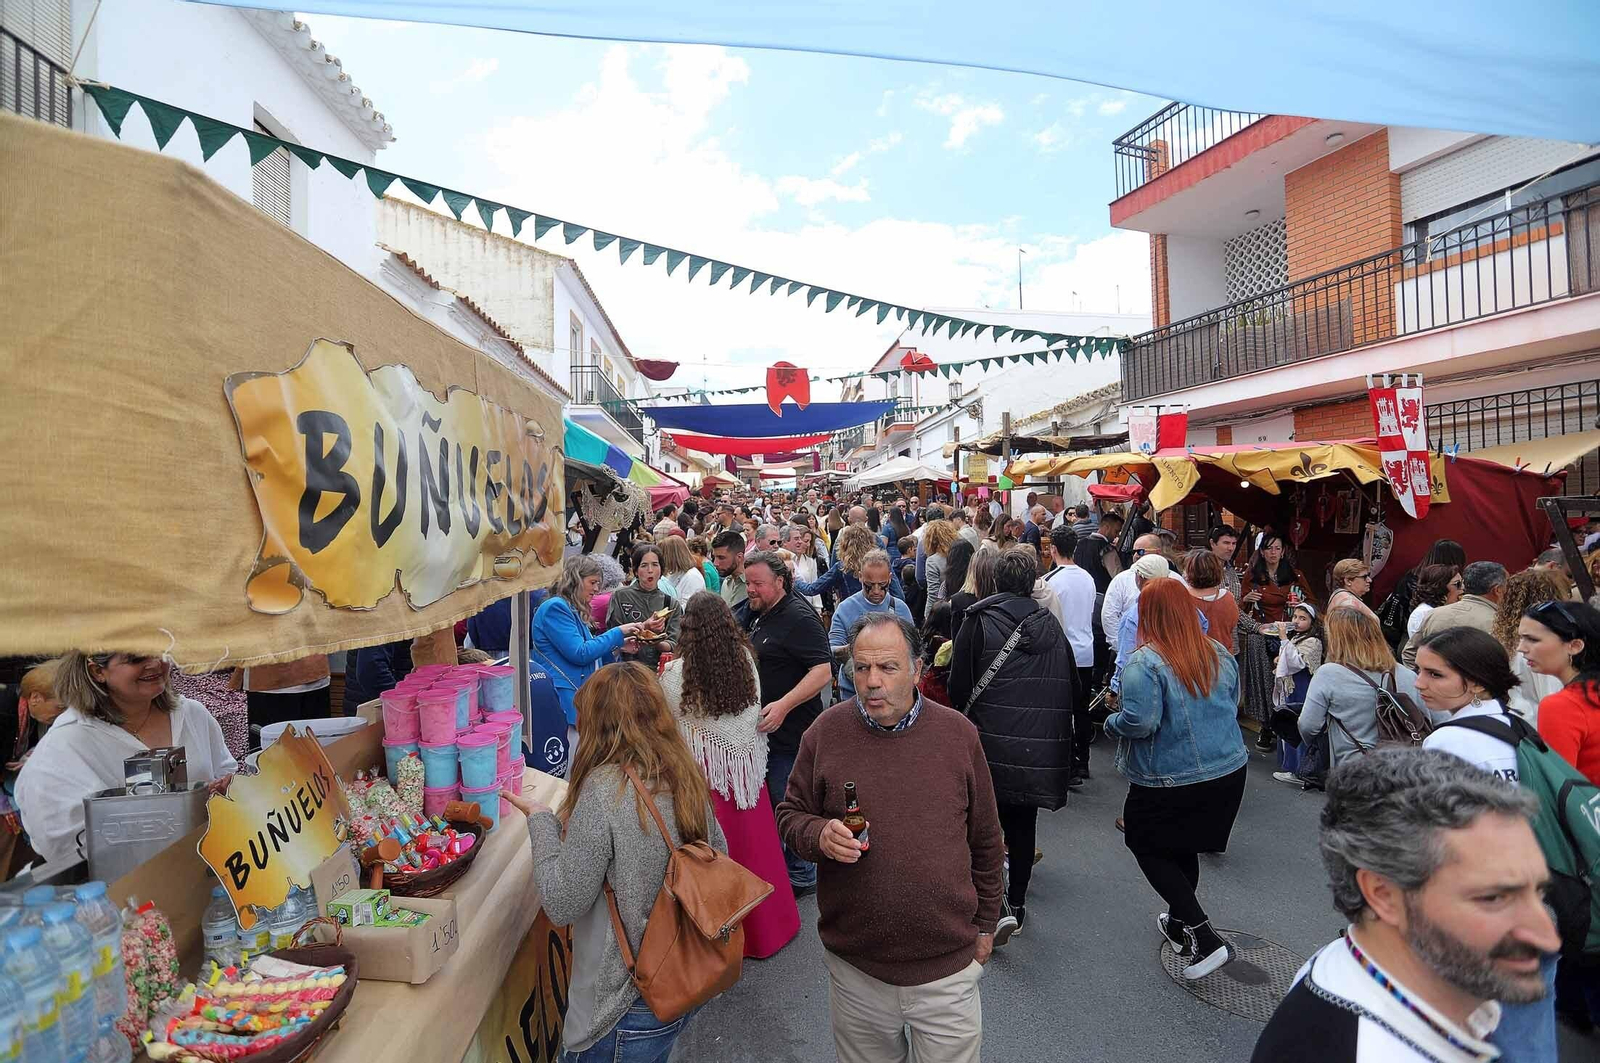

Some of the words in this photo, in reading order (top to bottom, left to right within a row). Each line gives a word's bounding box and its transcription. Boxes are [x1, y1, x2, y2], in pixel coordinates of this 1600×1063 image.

[297, 410, 548, 555] BUÑUELOS
[990, 651, 1008, 670] BIMBA
[1004, 631, 1021, 651] BIMBA
[224, 764, 331, 891] BUÑUELOS
